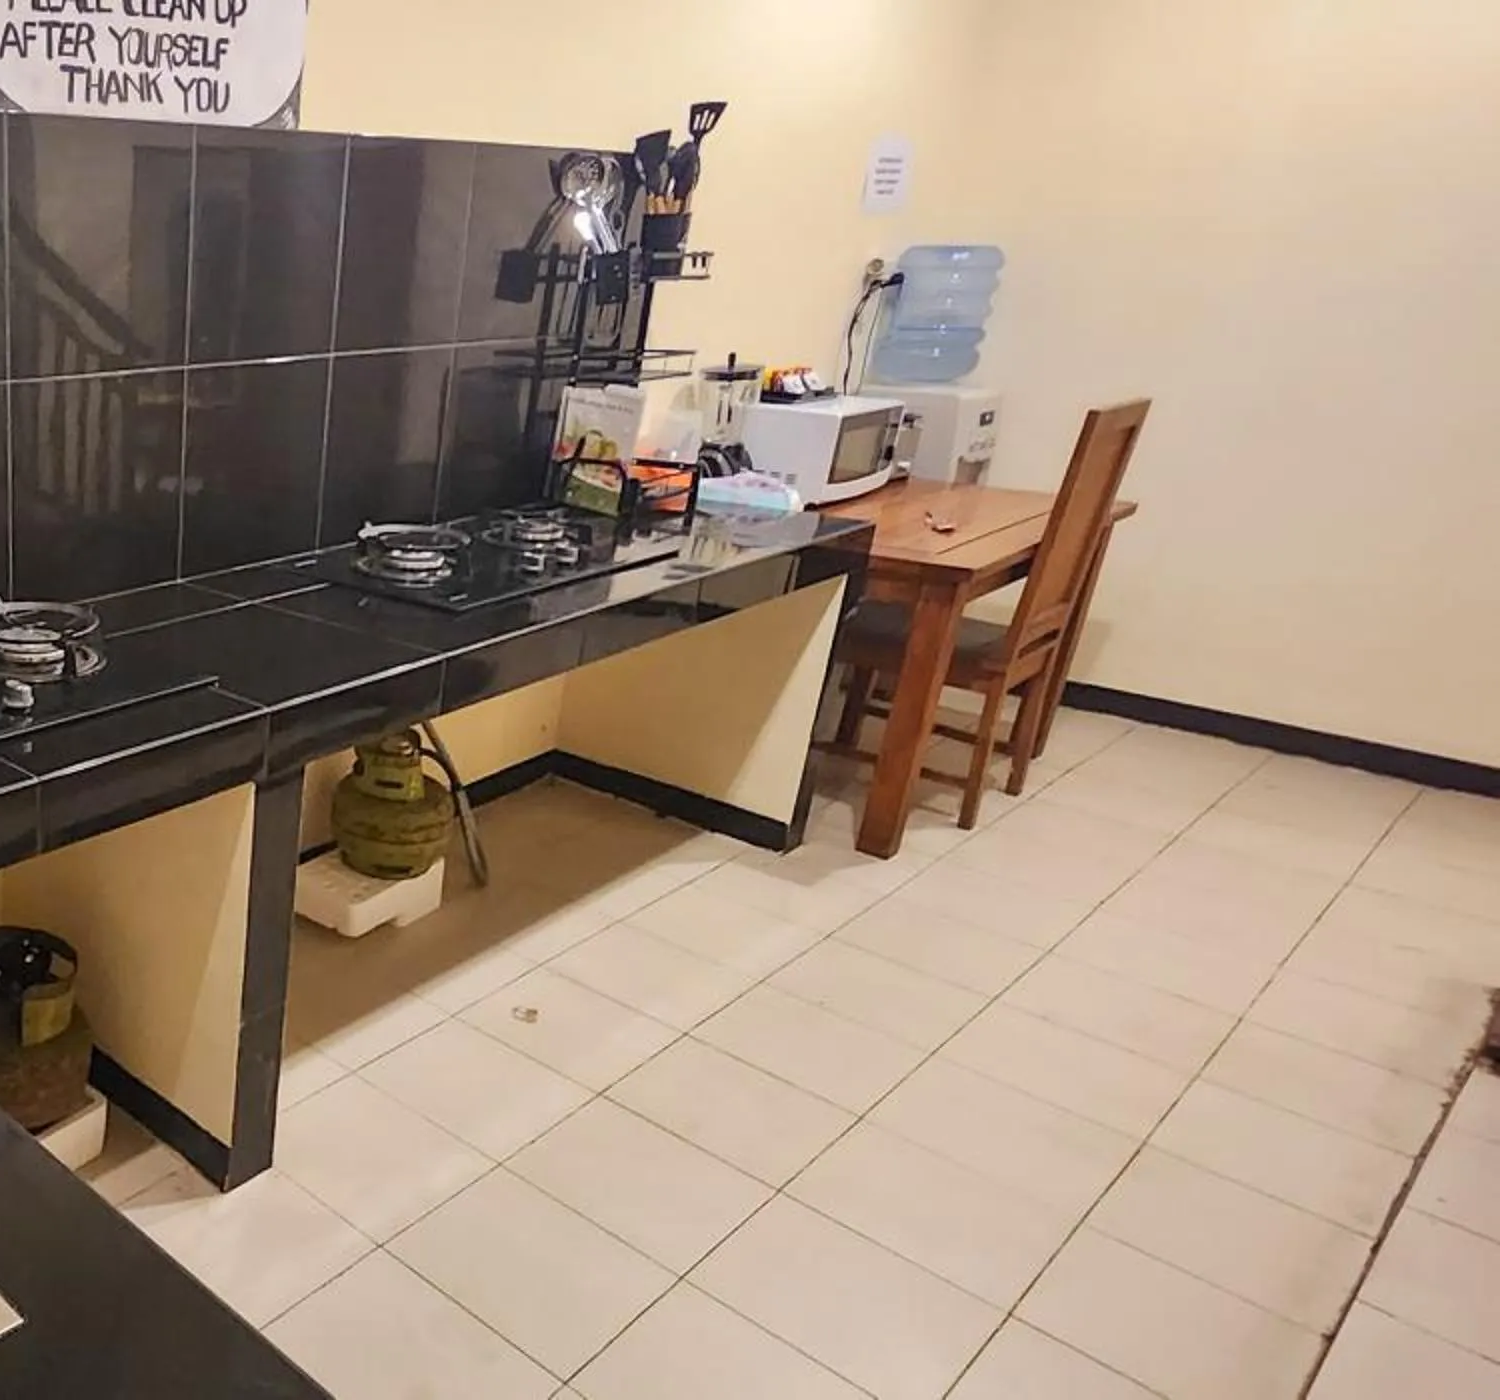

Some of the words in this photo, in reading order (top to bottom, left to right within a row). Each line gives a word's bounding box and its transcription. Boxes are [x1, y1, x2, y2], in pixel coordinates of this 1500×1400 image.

[215, 0, 247, 28] UP
[108, 26, 229, 70] YOURSELF
[60, 64, 164, 104] THANK
[173, 76, 230, 113] YOU
